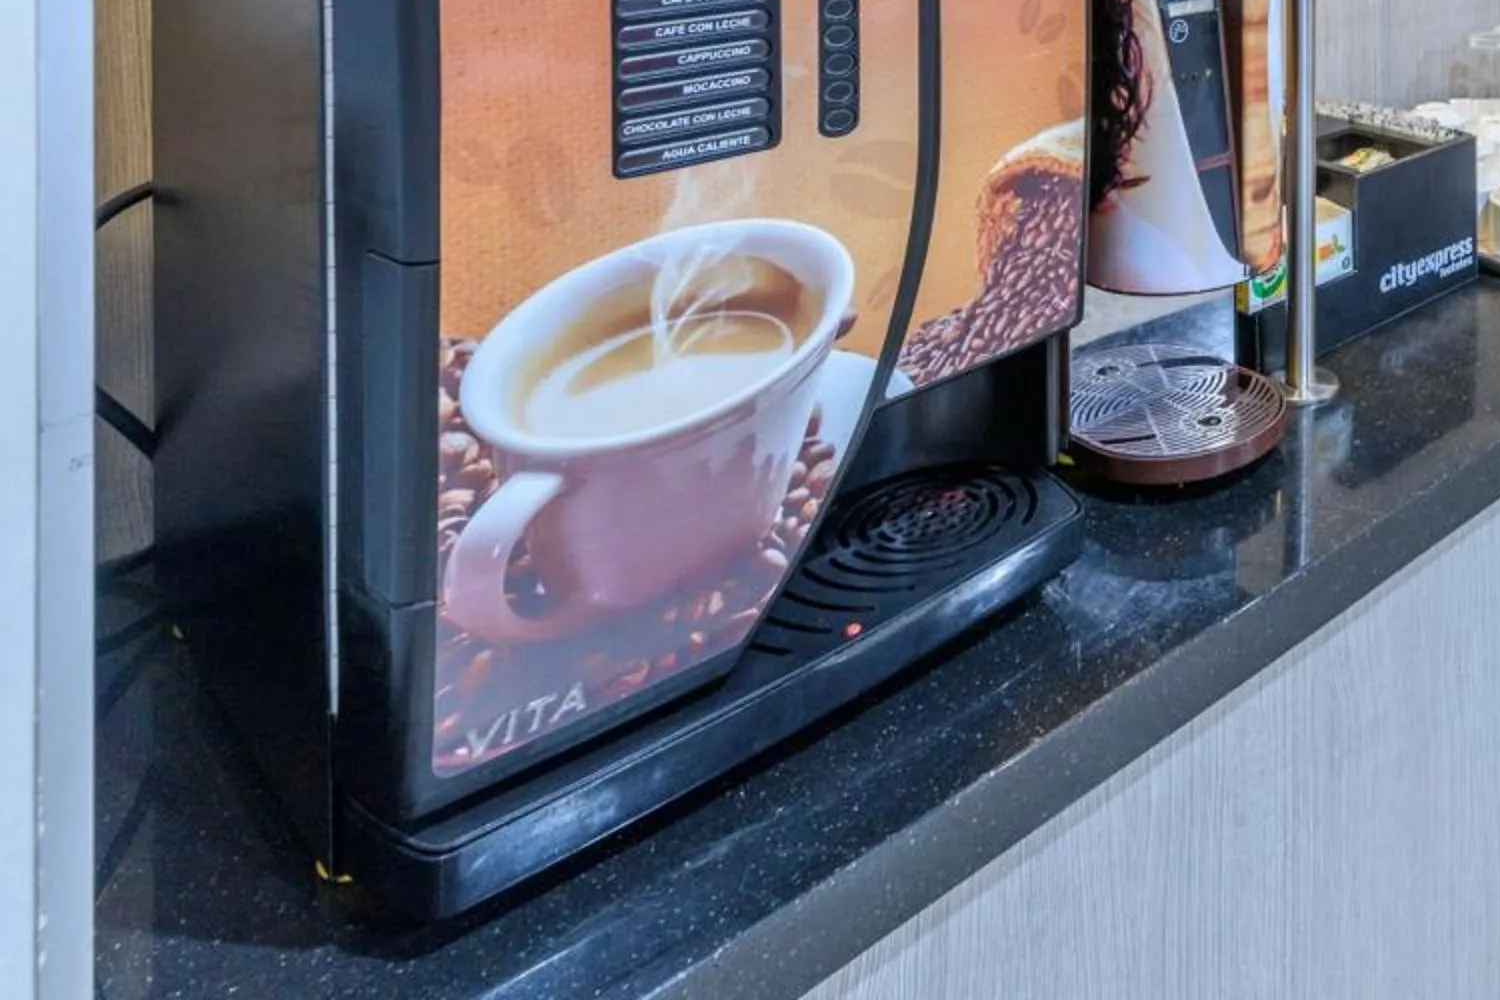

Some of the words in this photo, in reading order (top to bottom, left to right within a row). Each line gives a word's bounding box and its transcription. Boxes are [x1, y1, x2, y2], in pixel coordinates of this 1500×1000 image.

[688, 21, 713, 32] CON
[715, 17, 751, 29] LECHE
[677, 46, 751, 65] CAPPUCCINO
[682, 76, 751, 94] MOCACCINO
[623, 116, 690, 135] CHOCOLATE
[692, 112, 717, 124] CON
[718, 106, 752, 121] LECHE
[661, 146, 695, 160] AGUA
[697, 135, 751, 153] CALIENTE
[1379, 236, 1473, 294] cityexpress
[467, 681, 587, 759] VITA
